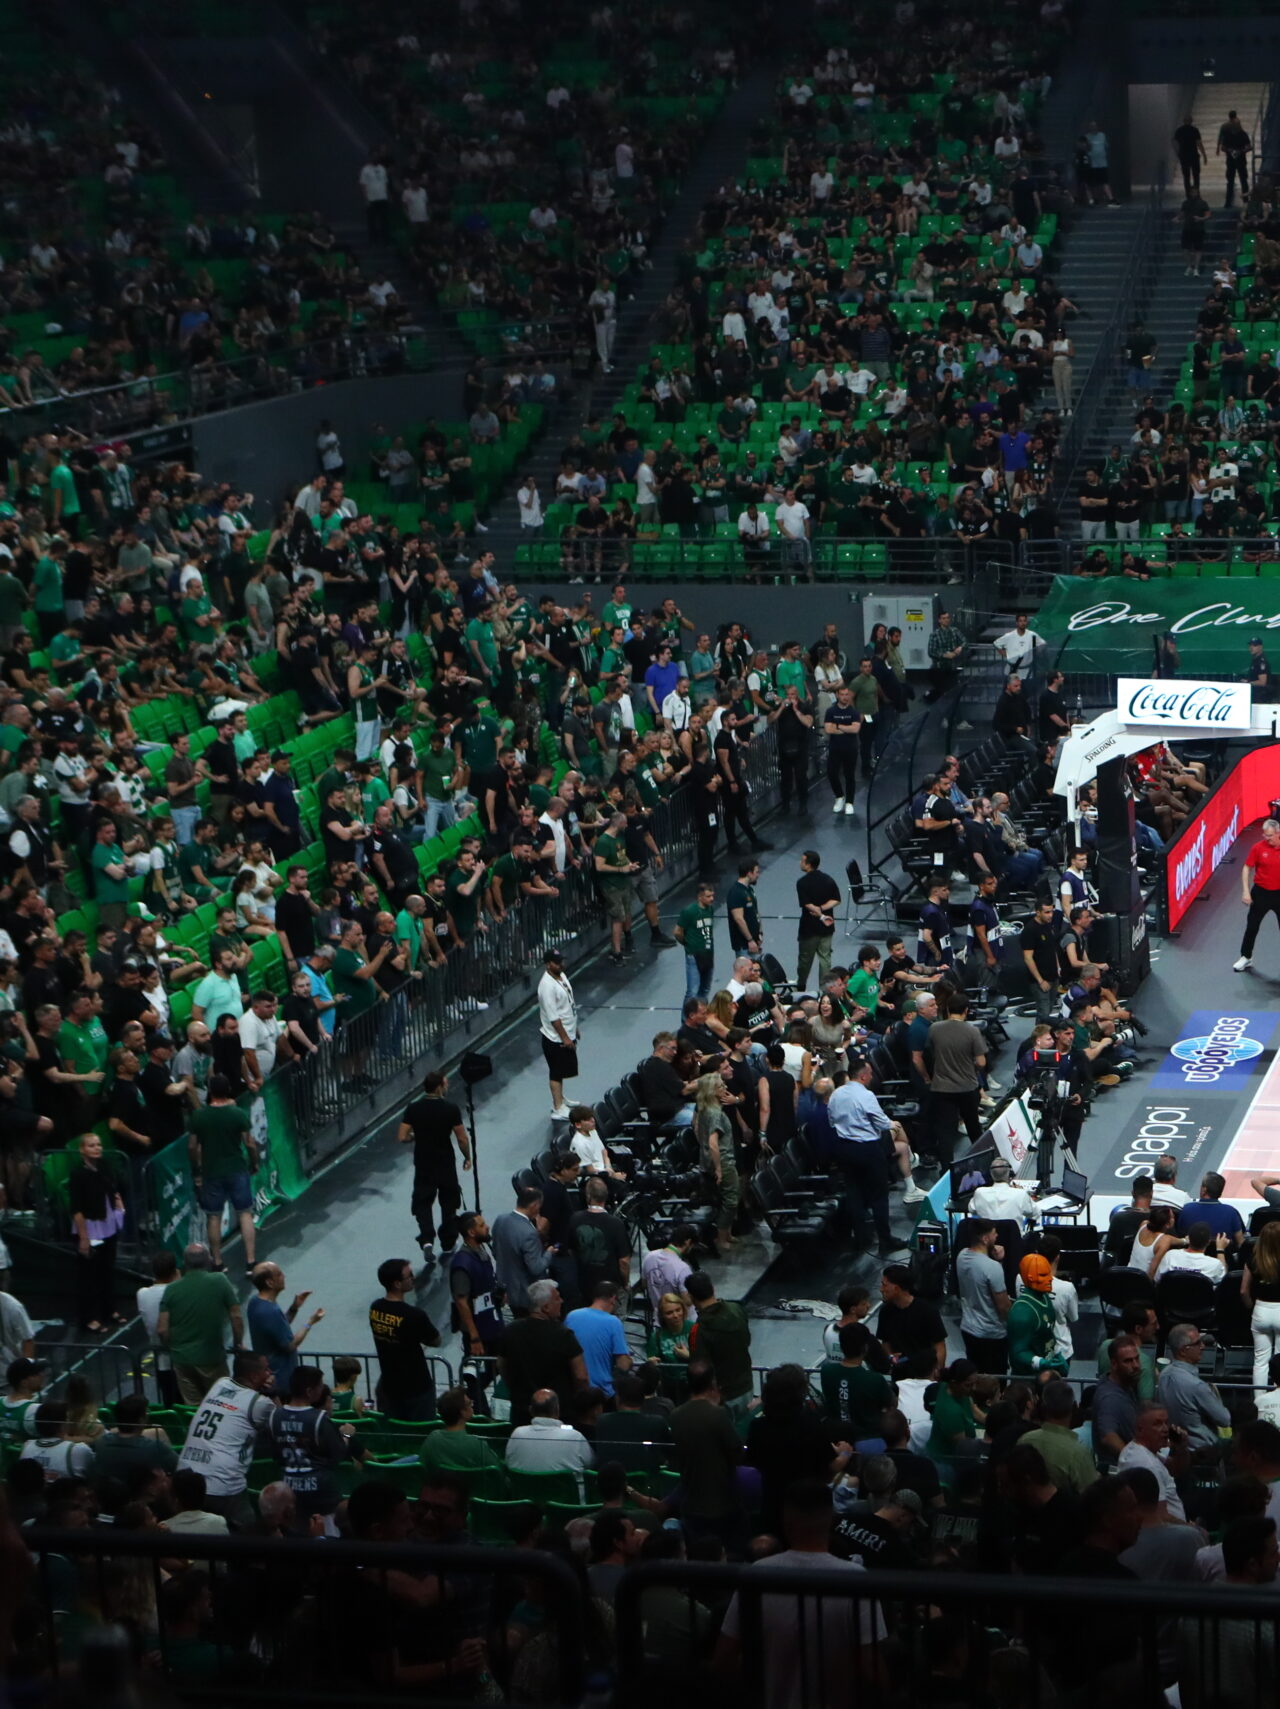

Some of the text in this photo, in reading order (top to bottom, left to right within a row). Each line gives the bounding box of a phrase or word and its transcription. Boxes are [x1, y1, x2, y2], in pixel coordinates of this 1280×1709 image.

[1068, 601, 1165, 632] One
[1085, 736, 1117, 763] SPALDING
[1114, 1106, 1195, 1179] snappi
[370, 1308, 404, 1329] ALLERY
[193, 1409, 224, 1441] 25
